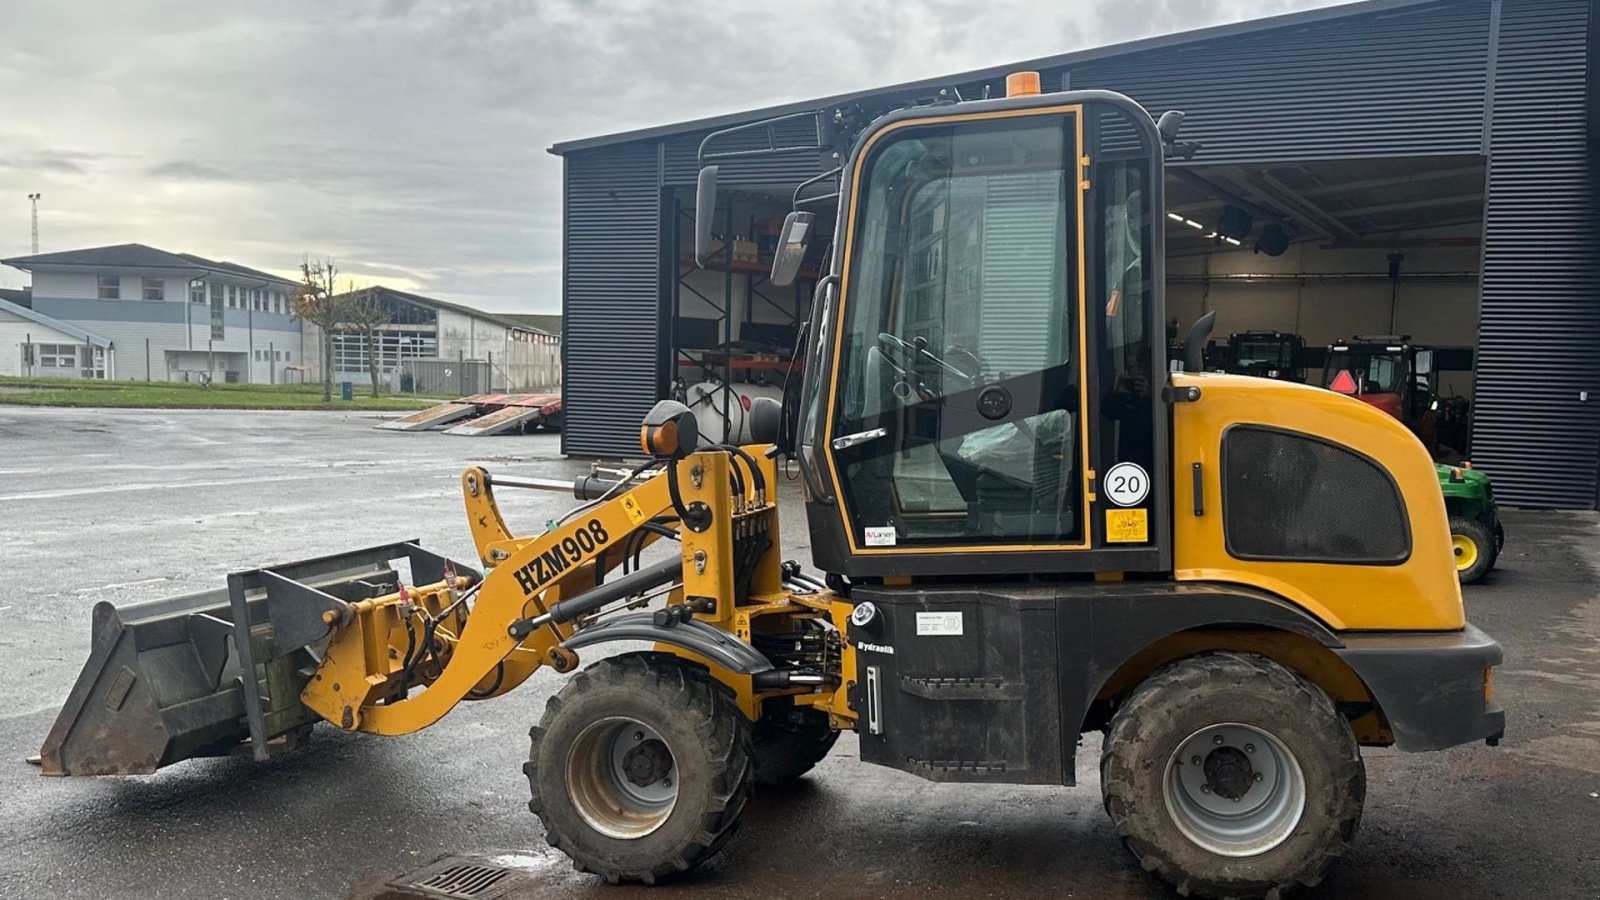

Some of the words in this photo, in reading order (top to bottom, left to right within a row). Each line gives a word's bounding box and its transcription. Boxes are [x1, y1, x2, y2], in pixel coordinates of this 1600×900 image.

[1113, 476, 1140, 493] 20
[513, 519, 609, 595] HZM908
[858, 641, 894, 655] Hydraulik
